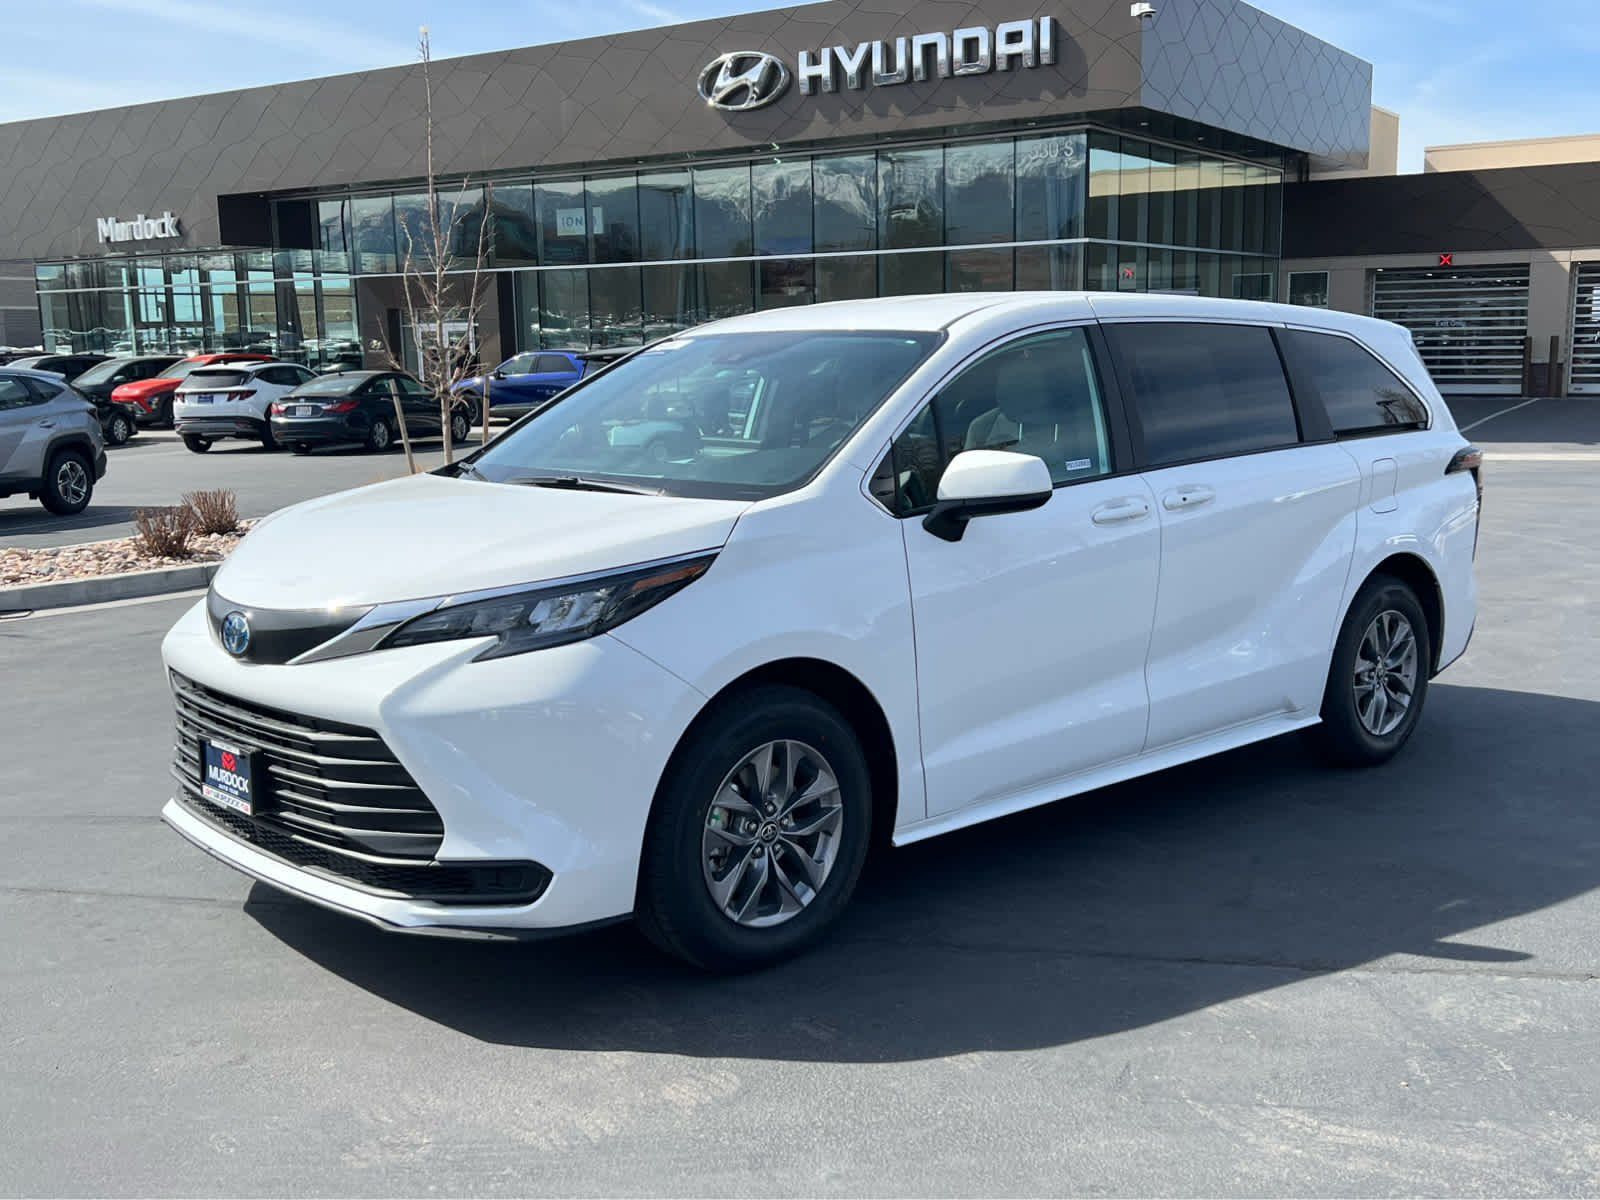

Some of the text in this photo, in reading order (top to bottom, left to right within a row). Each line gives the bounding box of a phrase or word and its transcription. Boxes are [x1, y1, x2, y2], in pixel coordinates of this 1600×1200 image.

[798, 15, 1055, 95] HYUNDAI
[97, 211, 180, 243] Murdock
[208, 764, 249, 794] MURDOCK
